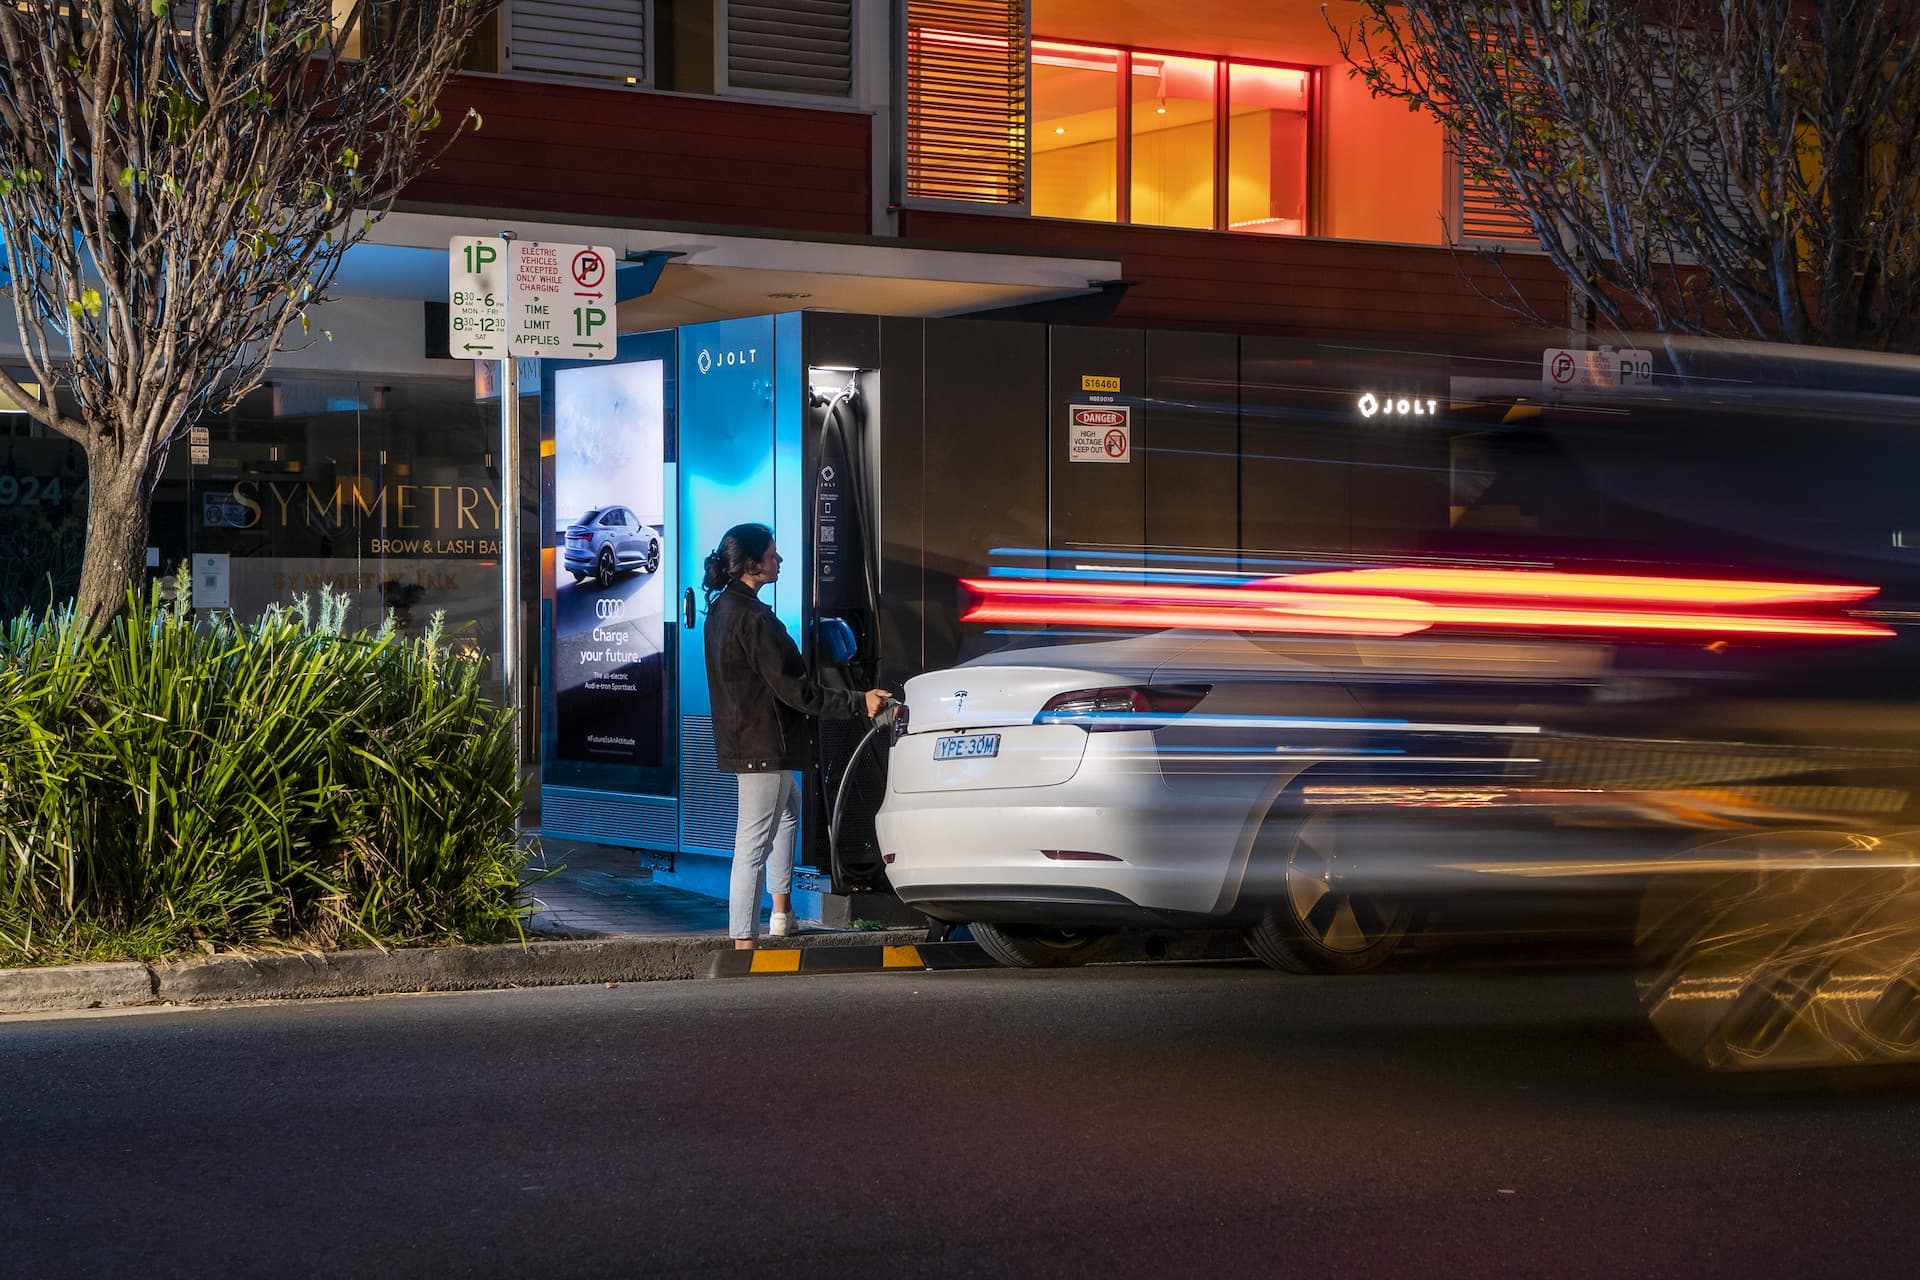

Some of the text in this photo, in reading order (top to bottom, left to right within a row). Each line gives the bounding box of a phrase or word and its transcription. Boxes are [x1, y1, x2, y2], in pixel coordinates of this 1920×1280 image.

[521, 247, 557, 257] ELECTRIC
[464, 245, 497, 274] 1P
[521, 256, 558, 266] VEHICLES
[520, 265, 559, 275] EXCEPTED
[516, 274, 563, 285] ONLY WHILE
[519, 283, 560, 293] CHARGING
[486, 308, 499, 316] FRI
[525, 304, 549, 315] TIME
[523, 319, 551, 331] LIMIT
[573, 307, 606, 337] 1P
[474, 333, 487, 341] SAT
[515, 334, 560, 346] APPLIES
[716, 349, 756, 367] JOLT
[1085, 378, 1118, 389] S16460
[1383, 399, 1437, 415] JOLT
[1083, 413, 1117, 424] DANGER
[1080, 430, 1096, 438] HIGH
[1073, 438, 1103, 446] VOLTAGE
[1072, 446, 1104, 455] KEEP OUT
[223, 479, 501, 530] SYMMETRY
[371, 538, 420, 554] BROW
[422, 539, 433, 554] &
[437, 539, 475, 555] LASH
[592, 628, 629, 646] Charge
[580, 649, 642, 665] your future.
[593, 671, 604, 680] The
[584, 682, 596, 690] Audi
[596, 682, 611, 691] e-tron
